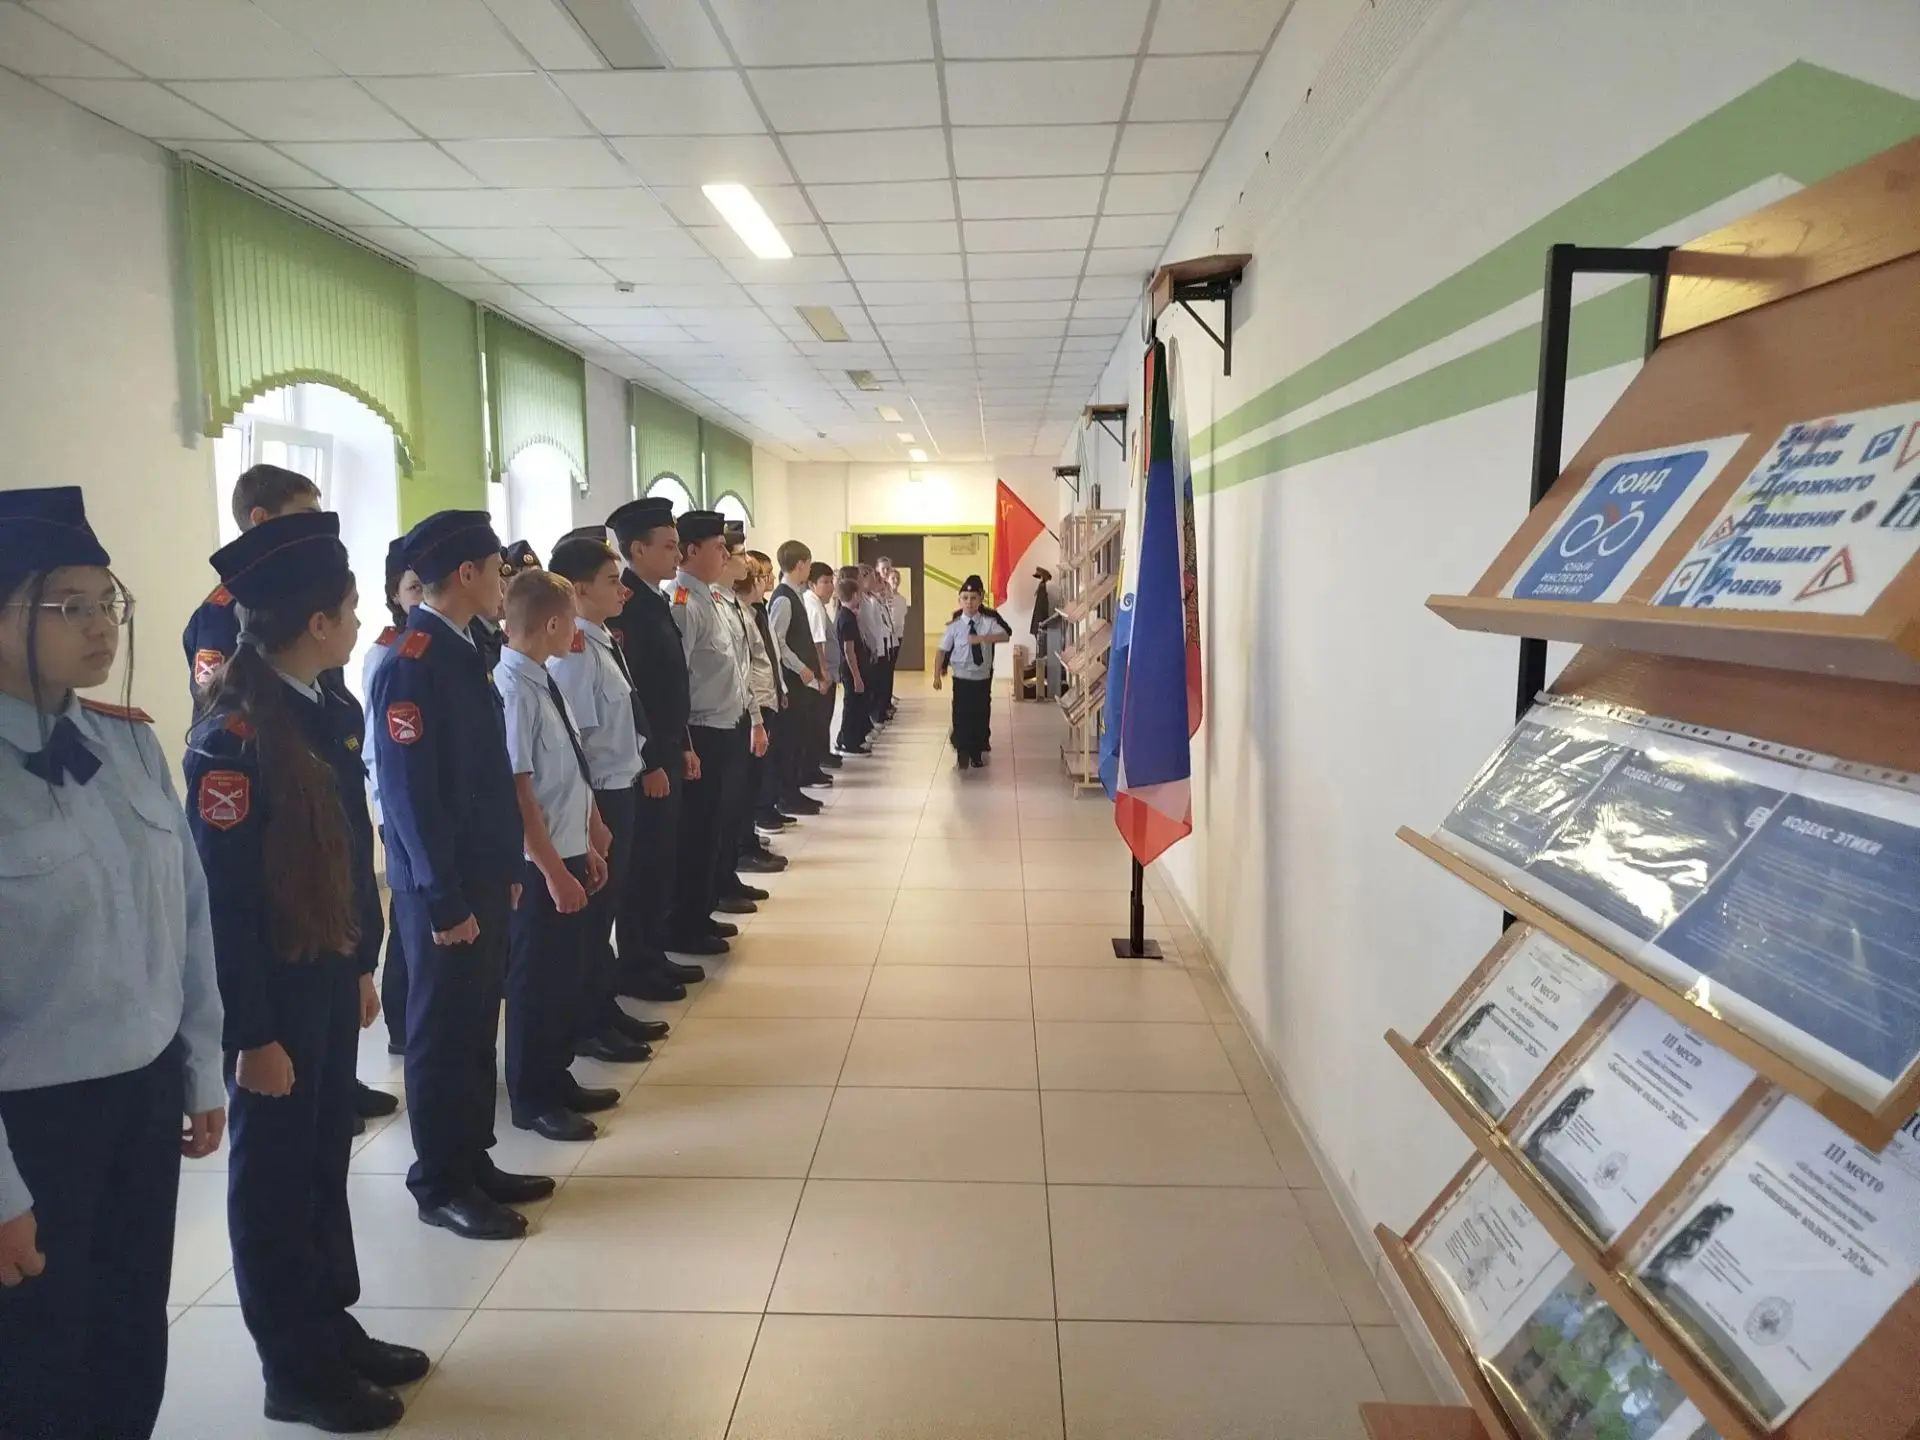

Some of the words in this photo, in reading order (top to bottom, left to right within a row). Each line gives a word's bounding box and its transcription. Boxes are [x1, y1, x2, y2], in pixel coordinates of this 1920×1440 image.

[1609, 468, 1672, 494] ЮИД
[1531, 583, 1584, 595] ДВИЖЕНИЯ
[1540, 572, 1594, 583] ИНСПЕКТОР
[1781, 815, 1836, 841] КОДЕКС
[1832, 831, 1884, 856] ЭТИКИ
[1661, 1032, 1679, 1049] III
[1675, 1044, 1703, 1067] место
[1824, 1142, 1847, 1165] III
[1844, 1160, 1885, 1194] место
